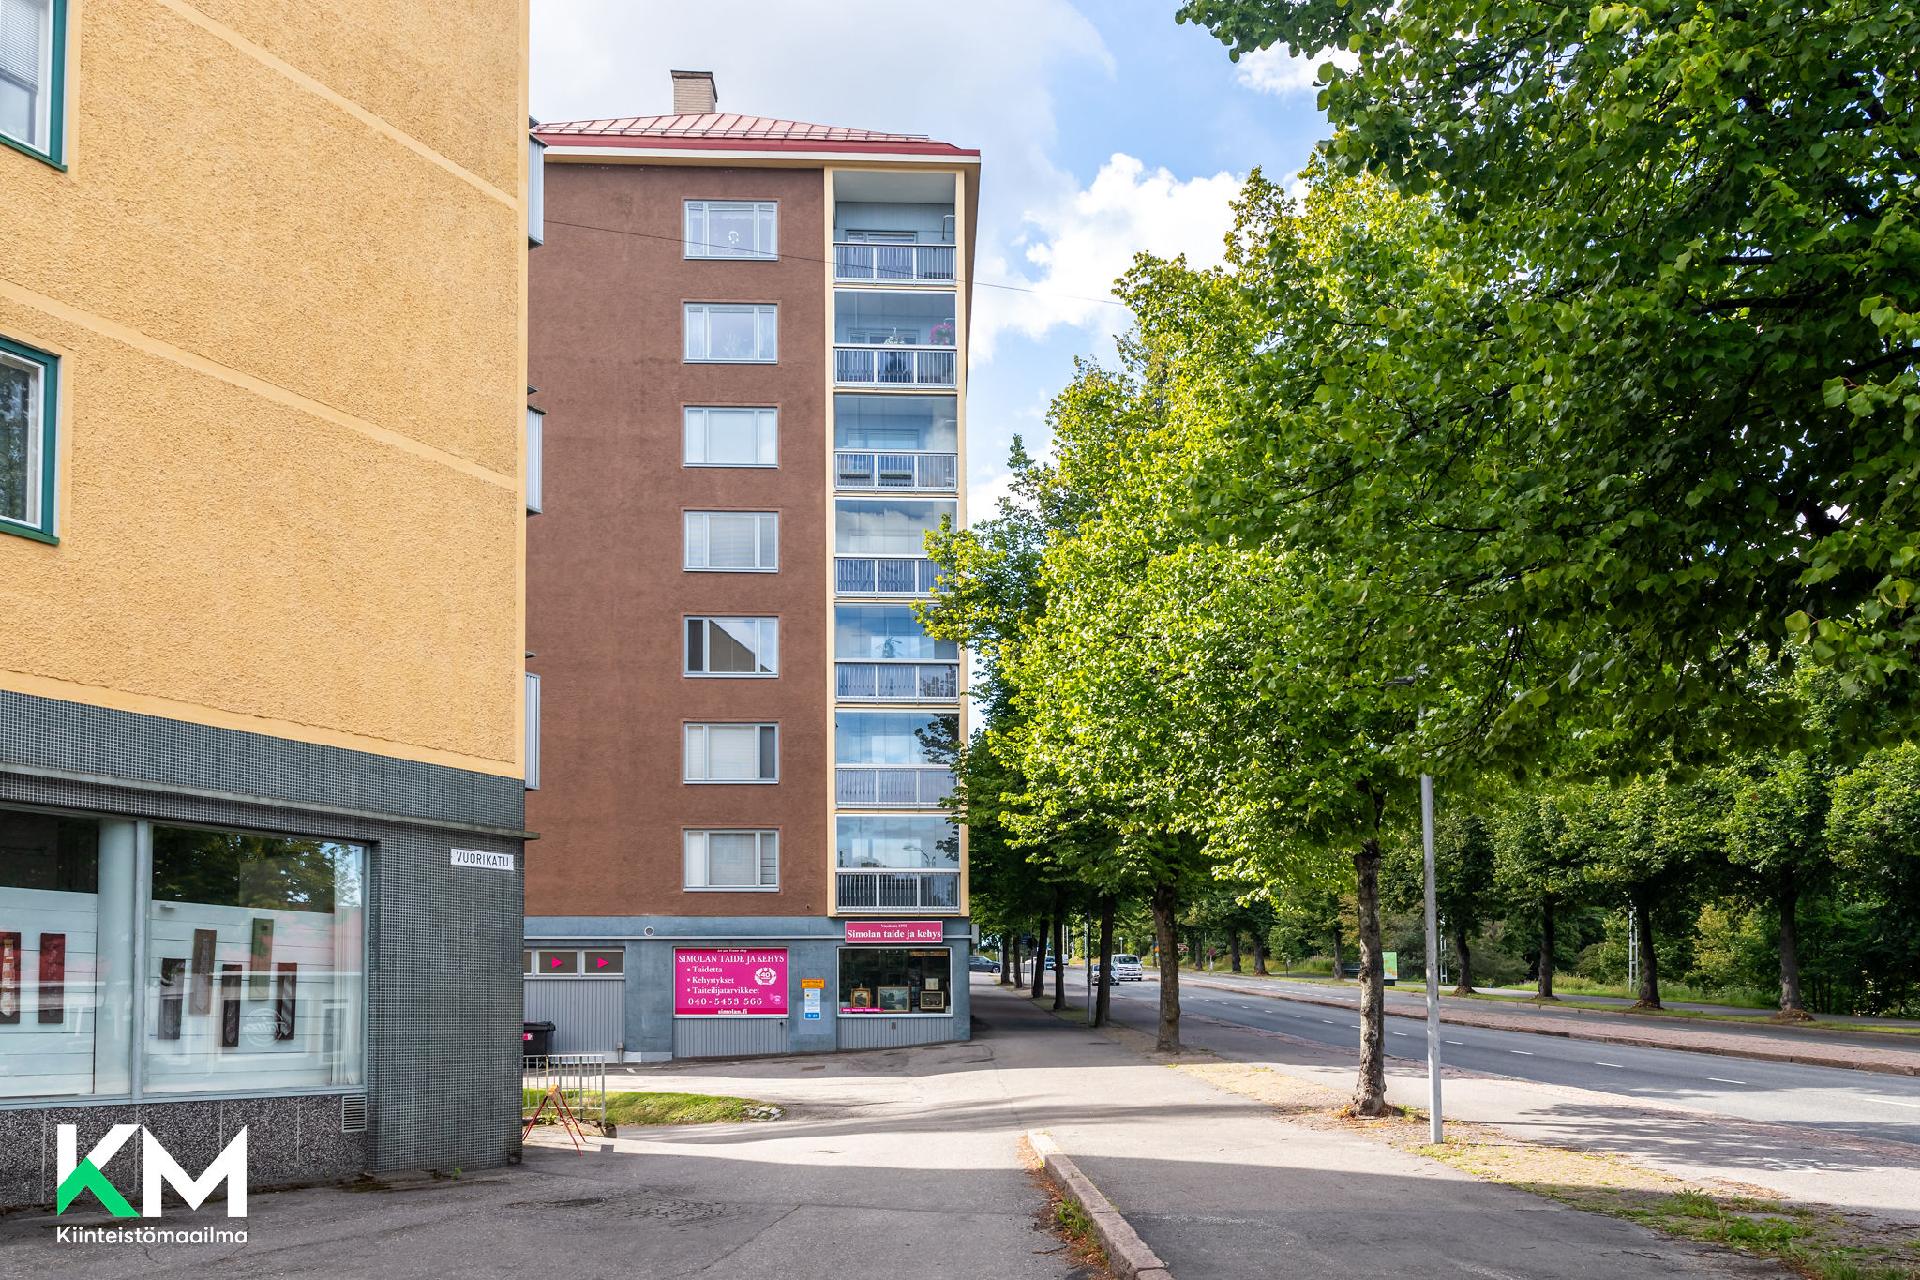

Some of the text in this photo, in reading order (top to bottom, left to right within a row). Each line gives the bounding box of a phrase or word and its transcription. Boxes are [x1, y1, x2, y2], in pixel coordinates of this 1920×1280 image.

[456, 851, 509, 867] VUORIKATU
[847, 930, 941, 940] Simolan taide ja kehys
[678, 955, 717, 963] SIMOLAN
[720, 955, 745, 963] TAIDE
[745, 955, 756, 965] JA
[692, 976, 735, 985] Kehystykset
